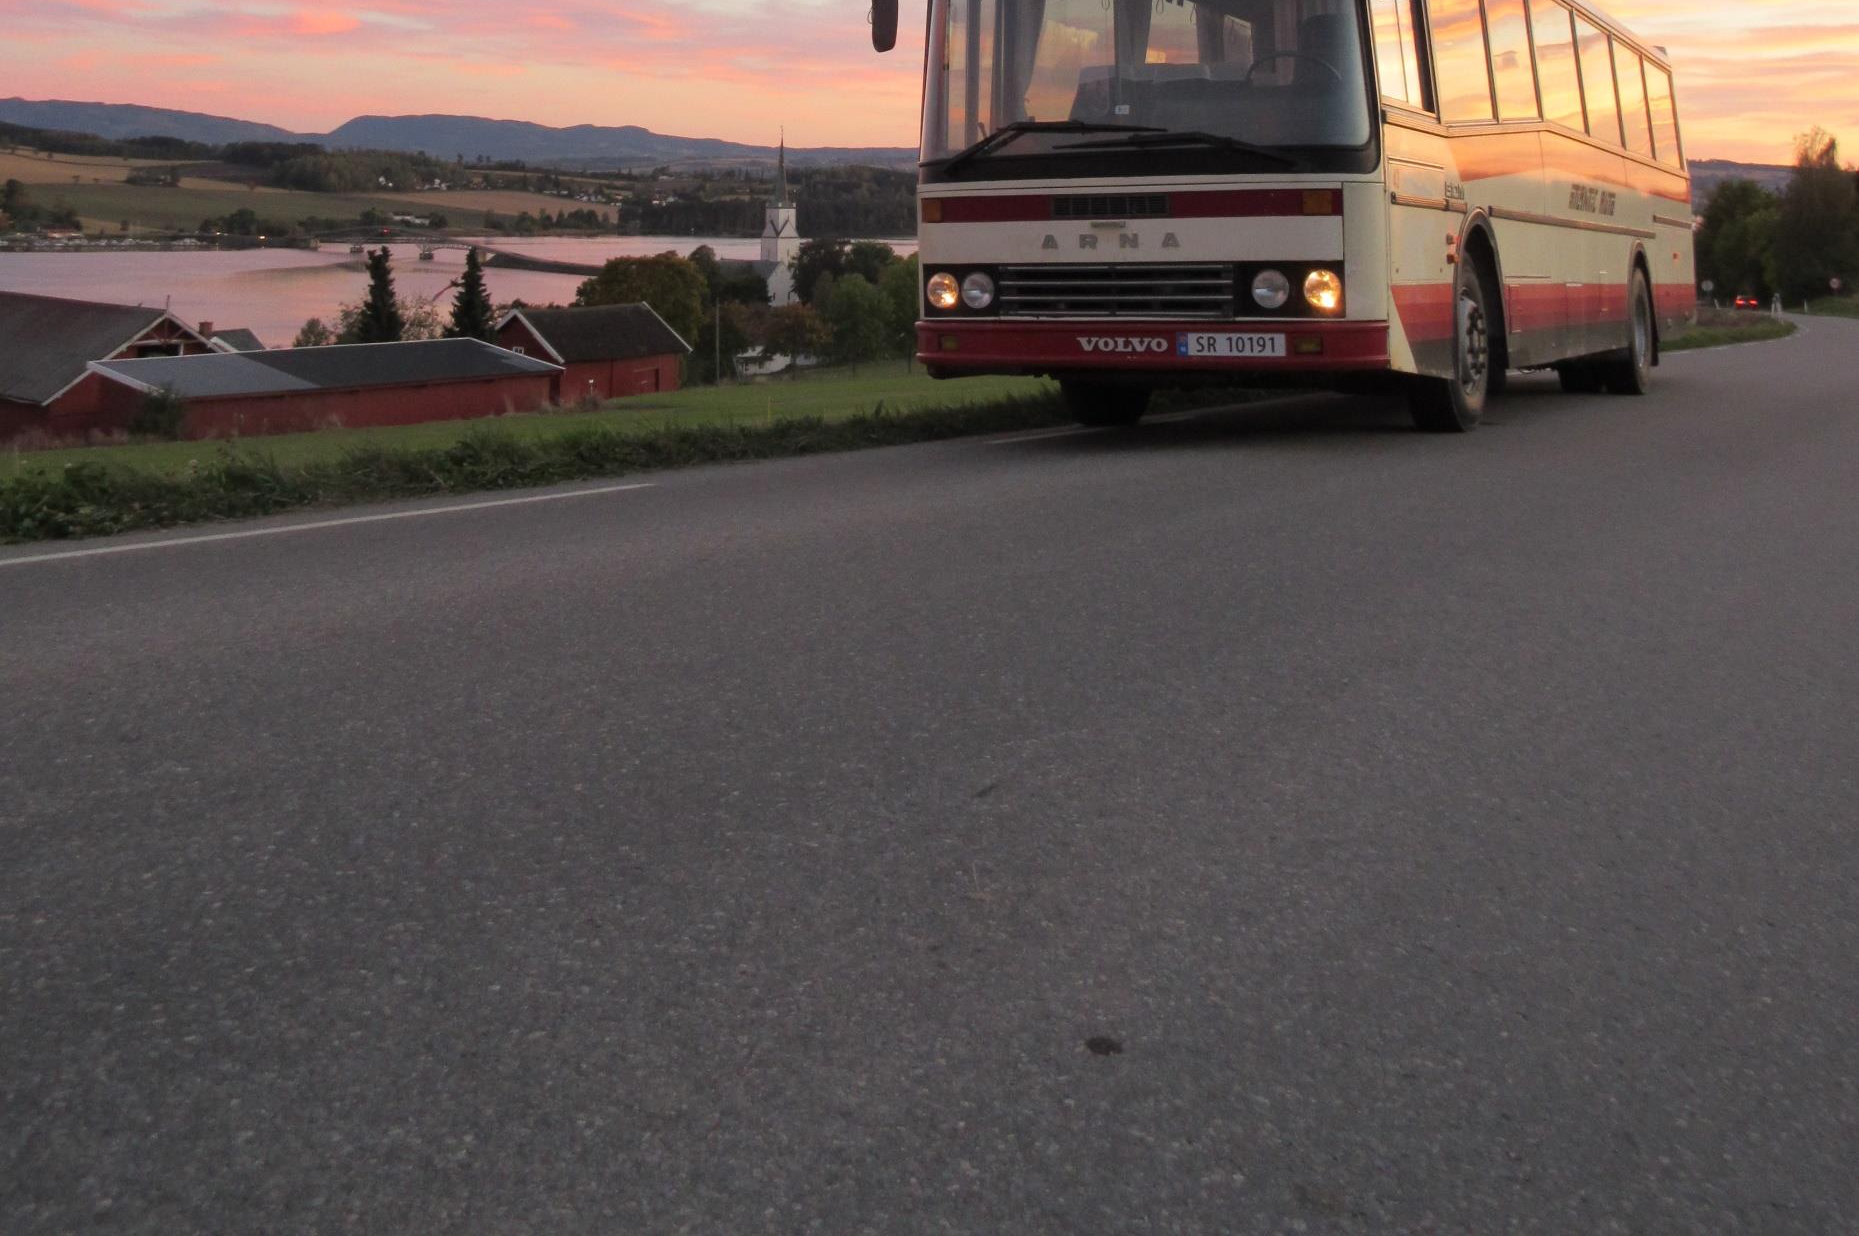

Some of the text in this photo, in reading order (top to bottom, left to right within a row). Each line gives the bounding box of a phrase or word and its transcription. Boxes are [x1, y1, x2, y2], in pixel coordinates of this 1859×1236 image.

[1041, 232, 1180, 250] ARNA
[1076, 337, 1169, 352] VOLVO
[1196, 336, 1217, 352] SR
[1226, 335, 1276, 353] 10191
